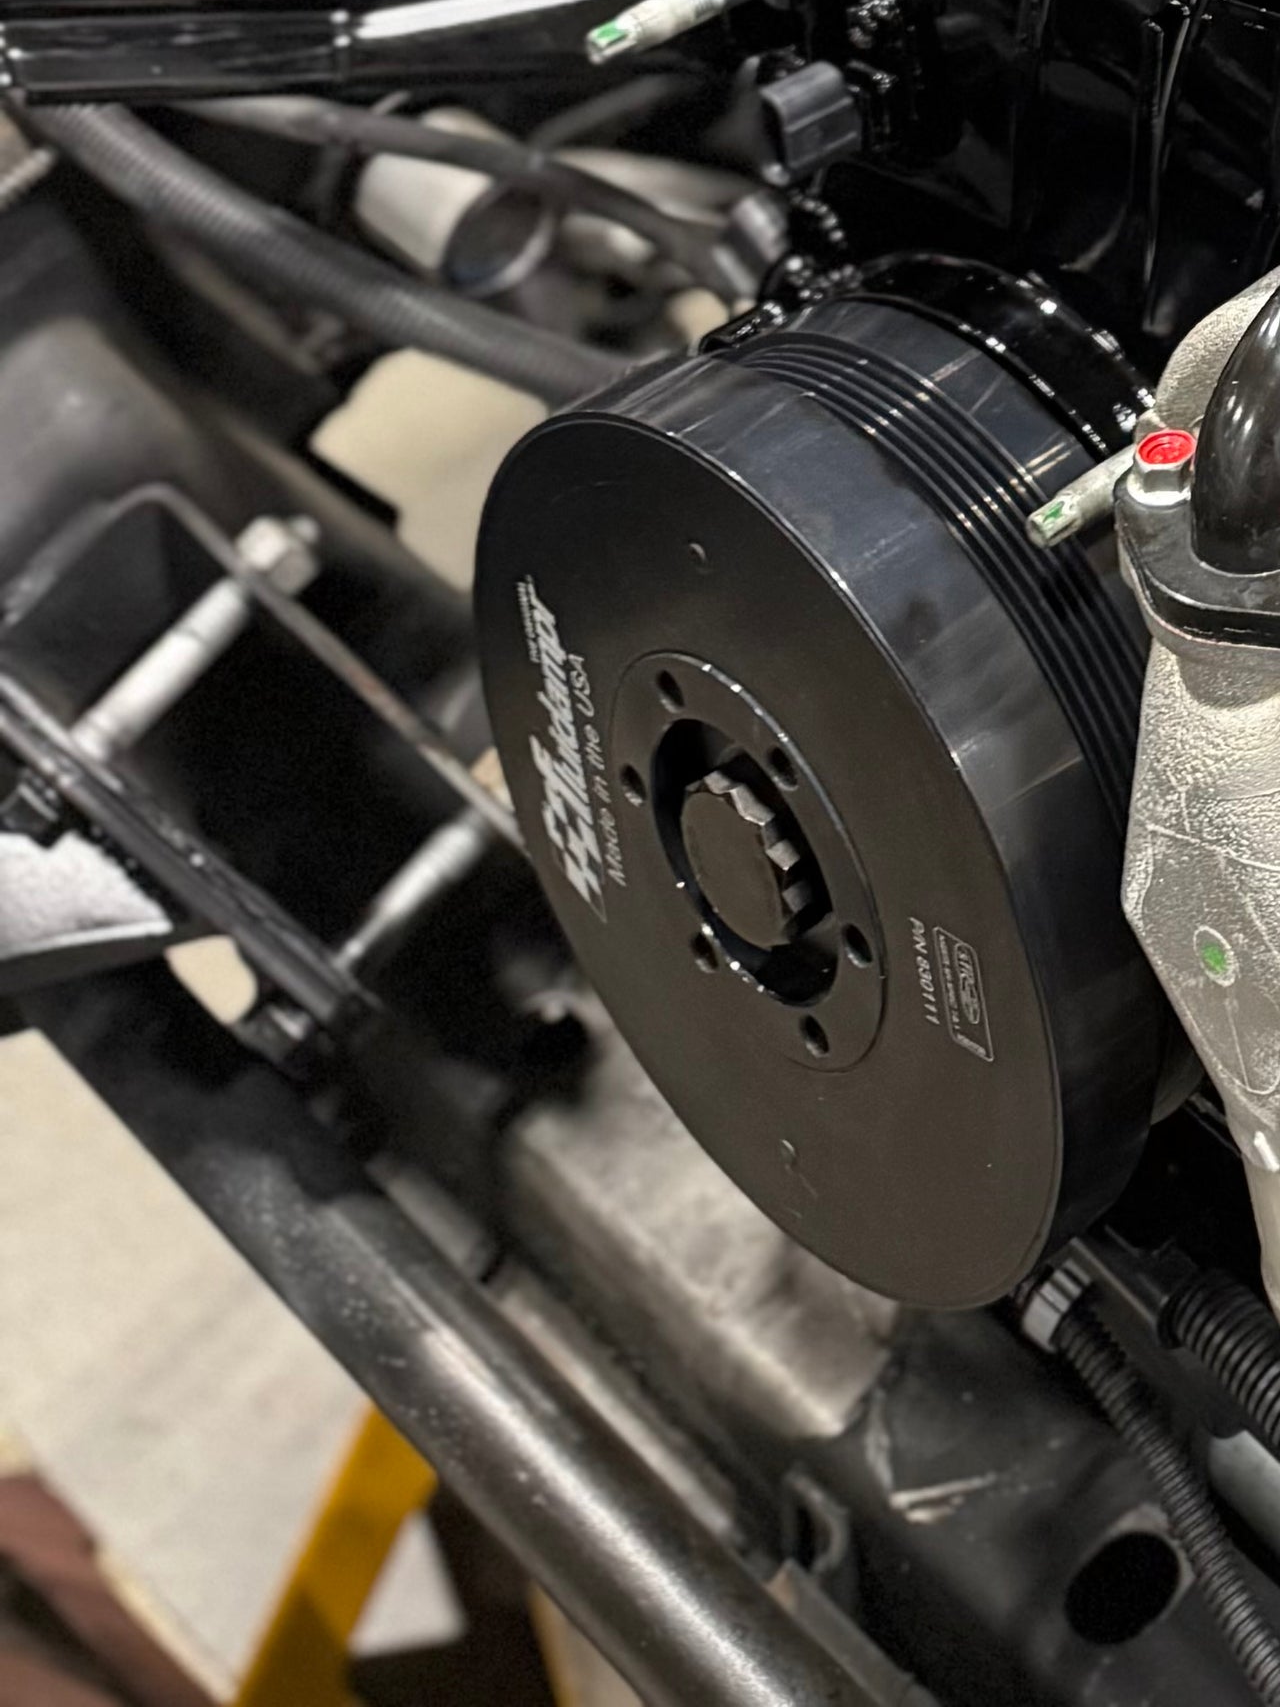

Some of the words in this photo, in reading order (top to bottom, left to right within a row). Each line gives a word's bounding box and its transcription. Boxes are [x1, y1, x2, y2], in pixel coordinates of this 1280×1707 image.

[567, 653, 595, 718] USA
[583, 723, 605, 770] the
[591, 774, 611, 803] in
[599, 808, 628, 887] Made
